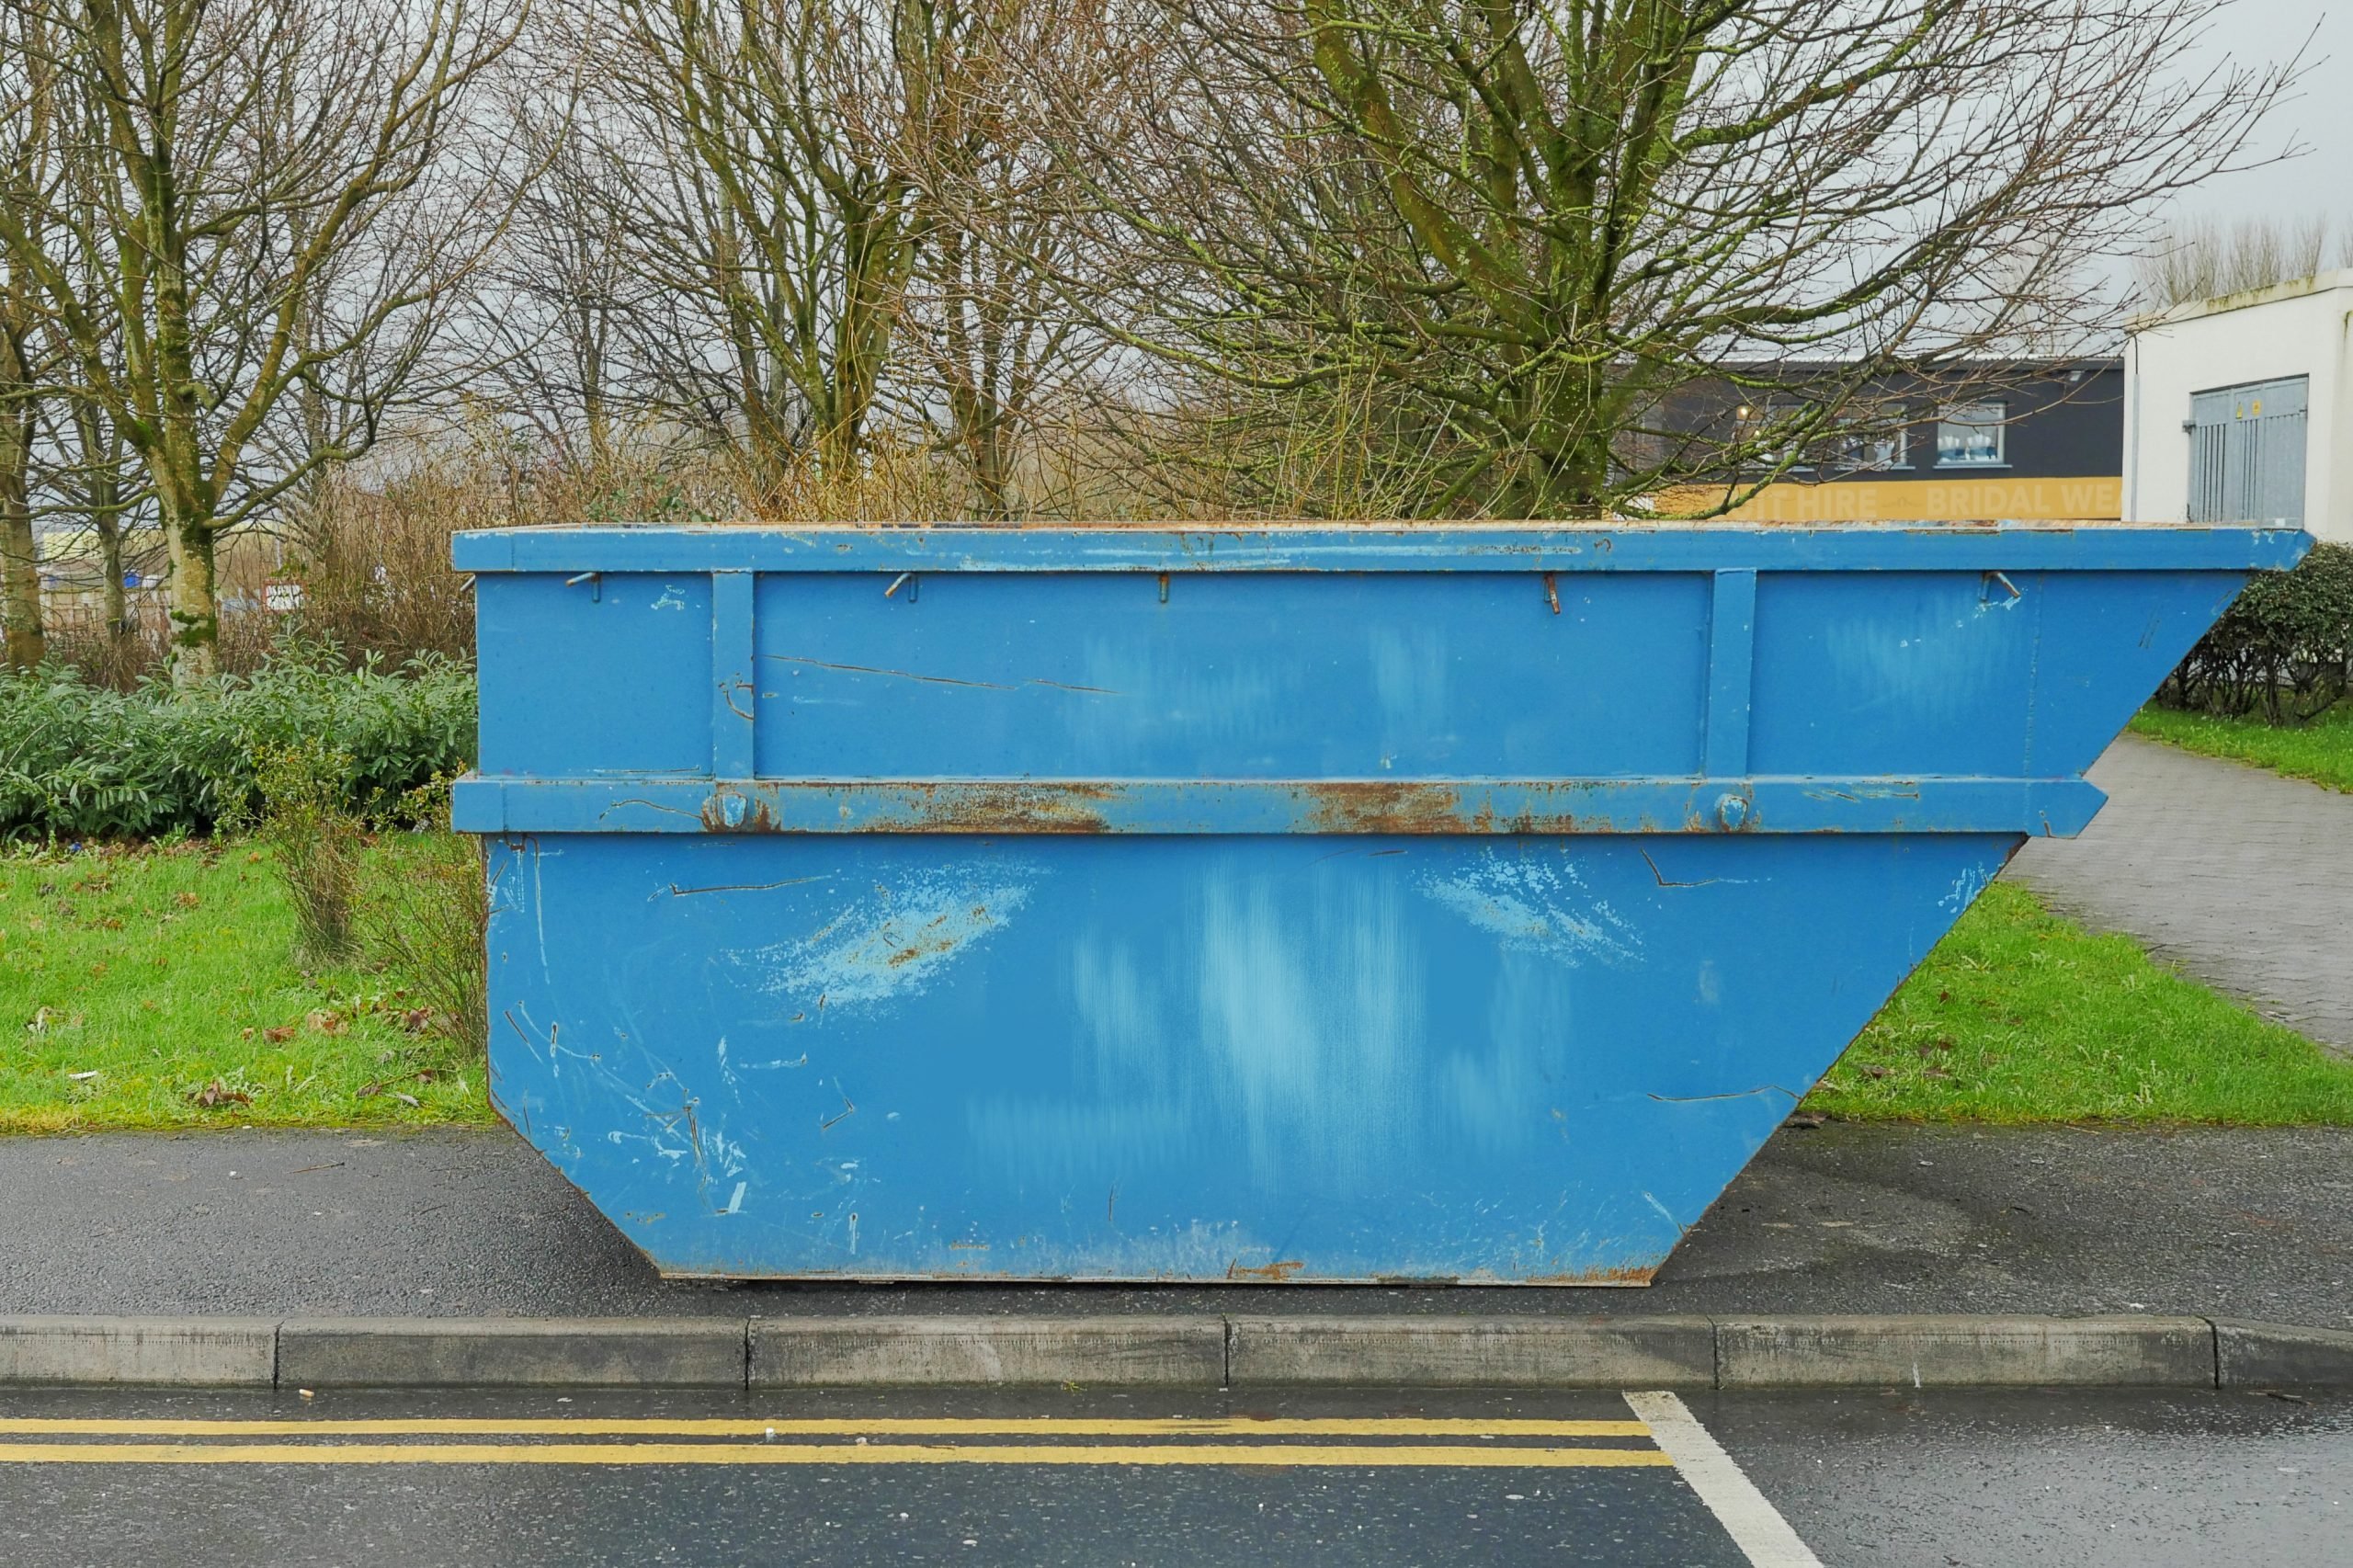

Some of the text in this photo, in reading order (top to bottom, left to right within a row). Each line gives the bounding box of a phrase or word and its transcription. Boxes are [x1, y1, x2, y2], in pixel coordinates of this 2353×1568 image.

[1798, 488, 1877, 517] HIRE
[1926, 484, 2051, 516] BRIDAL
[2061, 483, 2122, 513] WE
